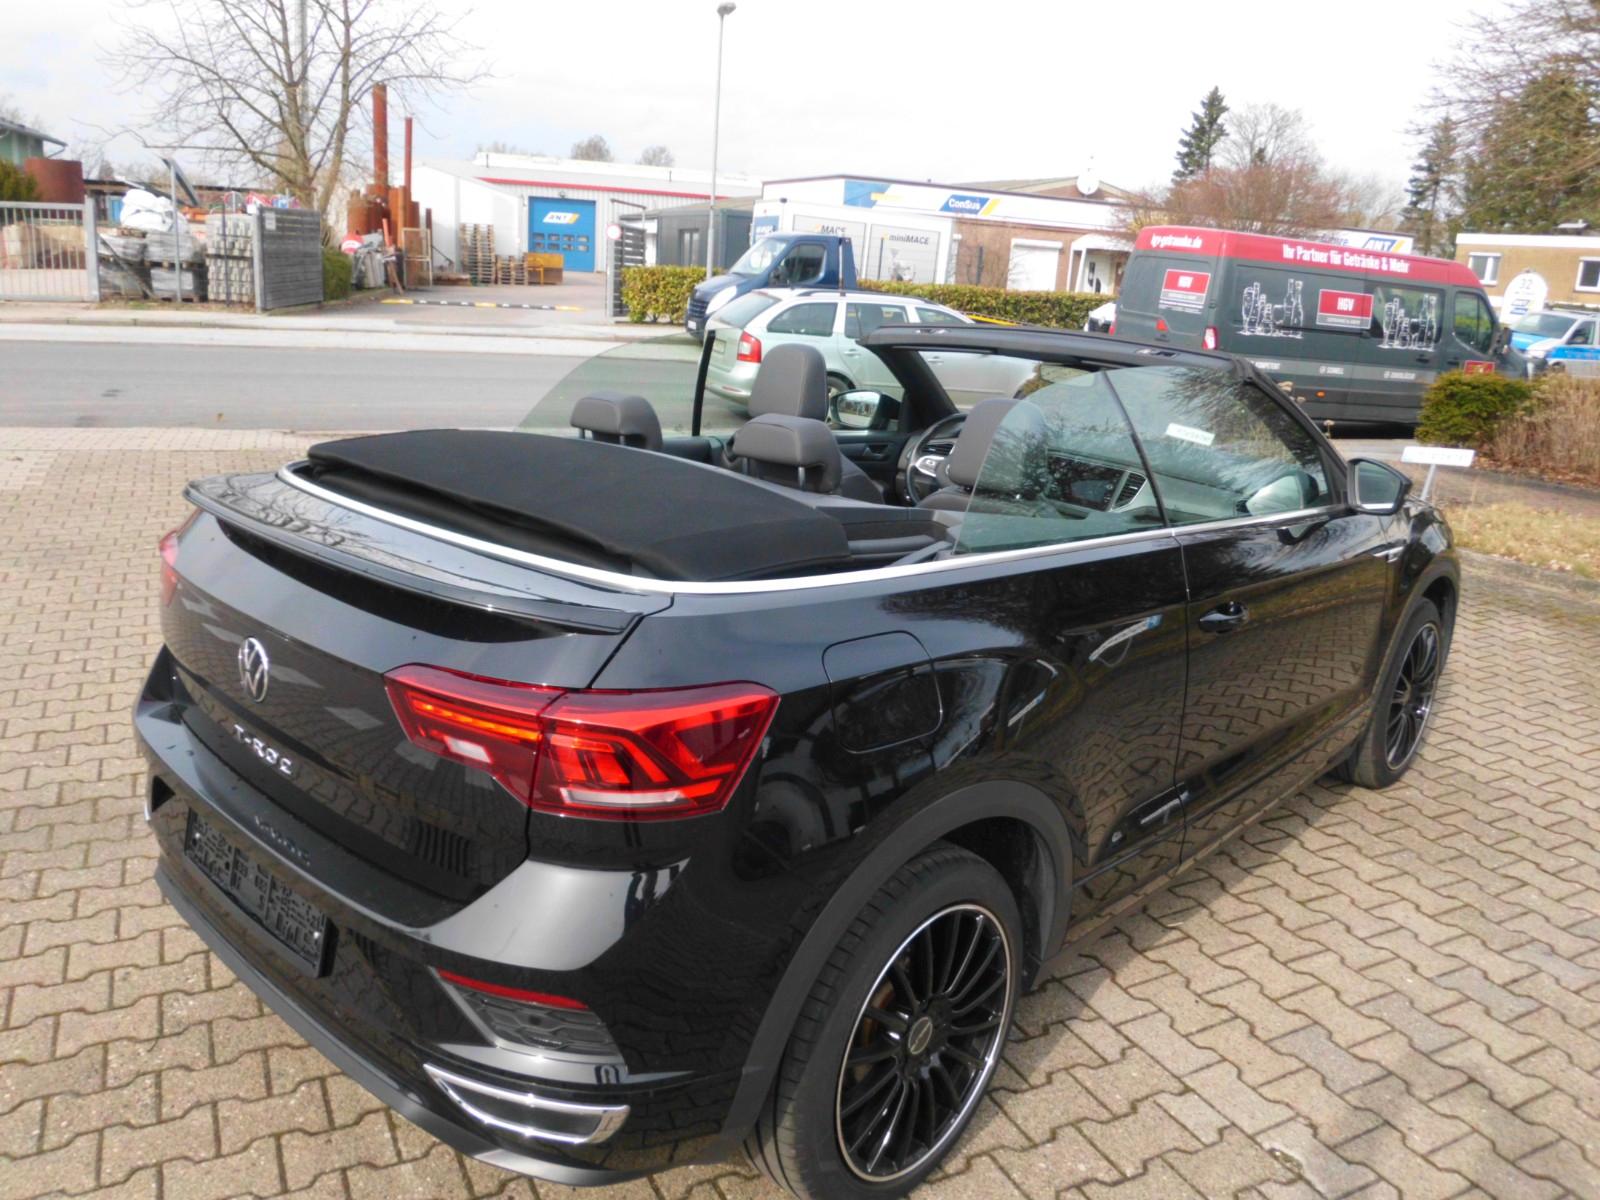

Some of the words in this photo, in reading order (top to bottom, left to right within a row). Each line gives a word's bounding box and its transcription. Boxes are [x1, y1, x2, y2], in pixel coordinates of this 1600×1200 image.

[889, 234, 930, 245] miniMACE
[1364, 239, 1392, 252] ANT
[1282, 244, 1296, 259] Ihr
[1296, 245, 1329, 263] Partner
[1329, 250, 1343, 265] für
[1343, 252, 1380, 271] Getränke
[1380, 257, 1389, 271] &
[1389, 258, 1411, 273] Mehr
[1337, 296, 1355, 311] HGV
[234, 724, 293, 776] T-ROC
